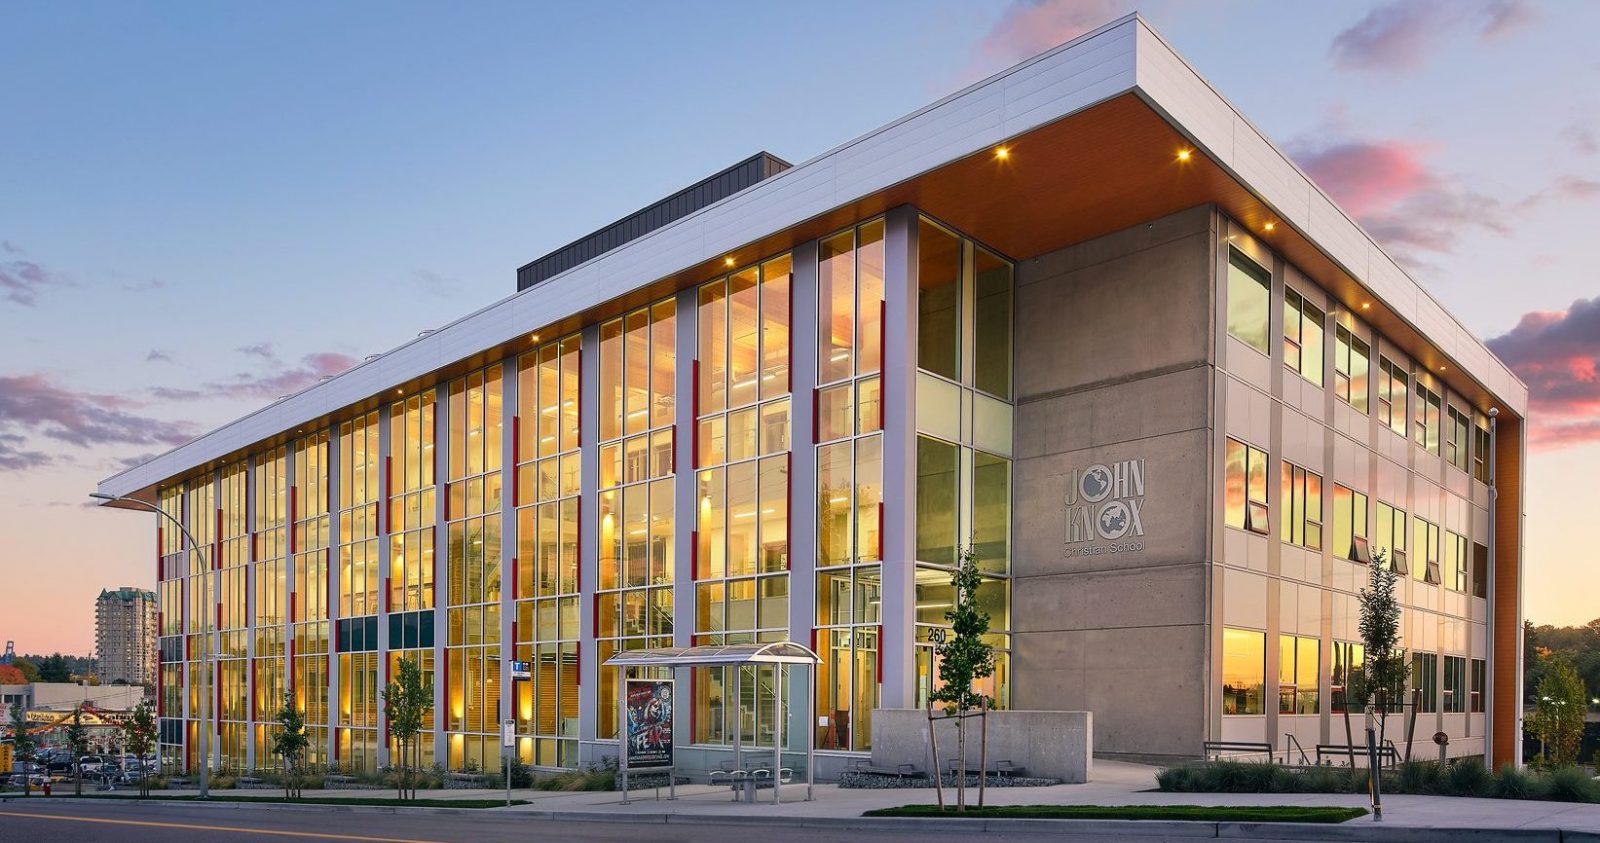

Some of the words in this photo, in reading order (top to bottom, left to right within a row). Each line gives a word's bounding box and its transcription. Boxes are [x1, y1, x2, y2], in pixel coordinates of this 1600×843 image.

[1064, 459, 1145, 506] JOHN
[1064, 499, 1144, 544] KNOX
[1064, 545, 1106, 558] Christian
[1109, 541, 1145, 553] School
[928, 628, 946, 643] 260
[514, 662, 520, 671] T
